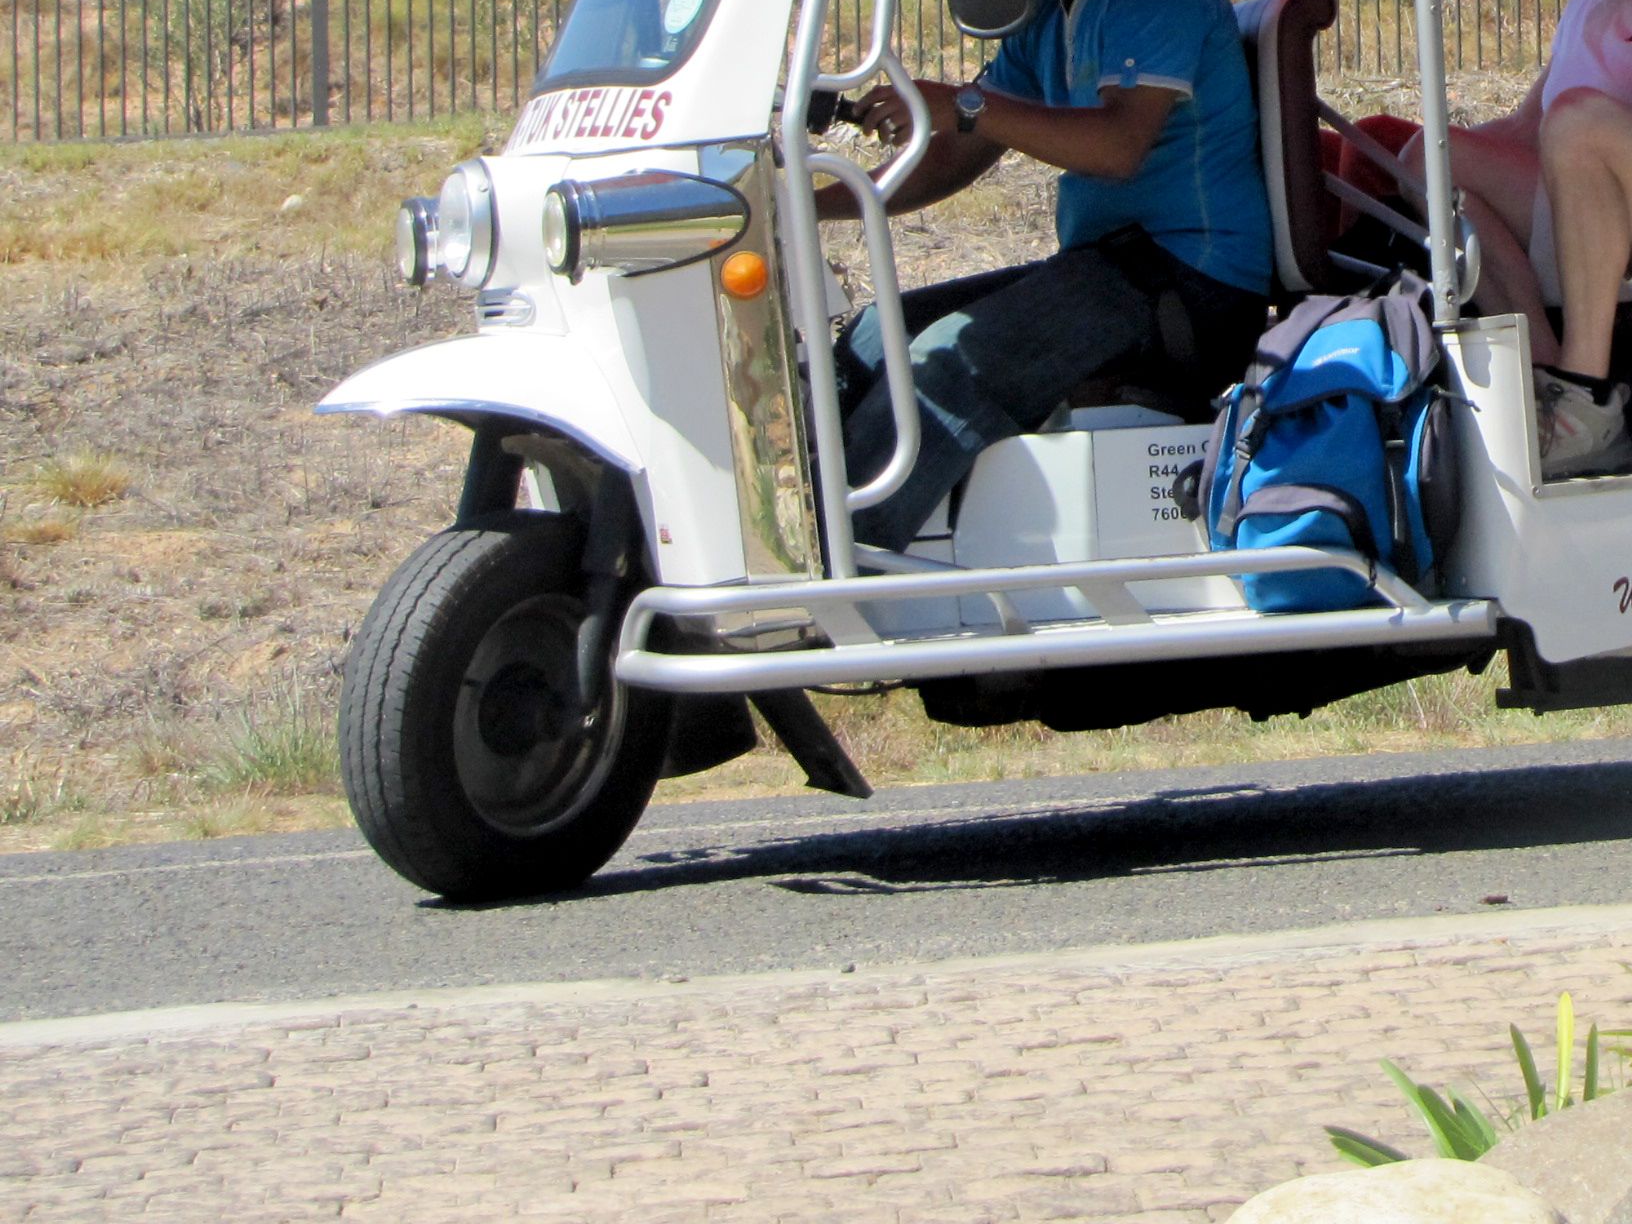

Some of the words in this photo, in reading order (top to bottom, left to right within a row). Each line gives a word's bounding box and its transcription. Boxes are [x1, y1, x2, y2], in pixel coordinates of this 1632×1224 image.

[552, 88, 673, 140] STELLIES
[1148, 443, 1196, 457] Green
[1149, 464, 1178, 478] R44
[1151, 486, 1174, 500] Ste
